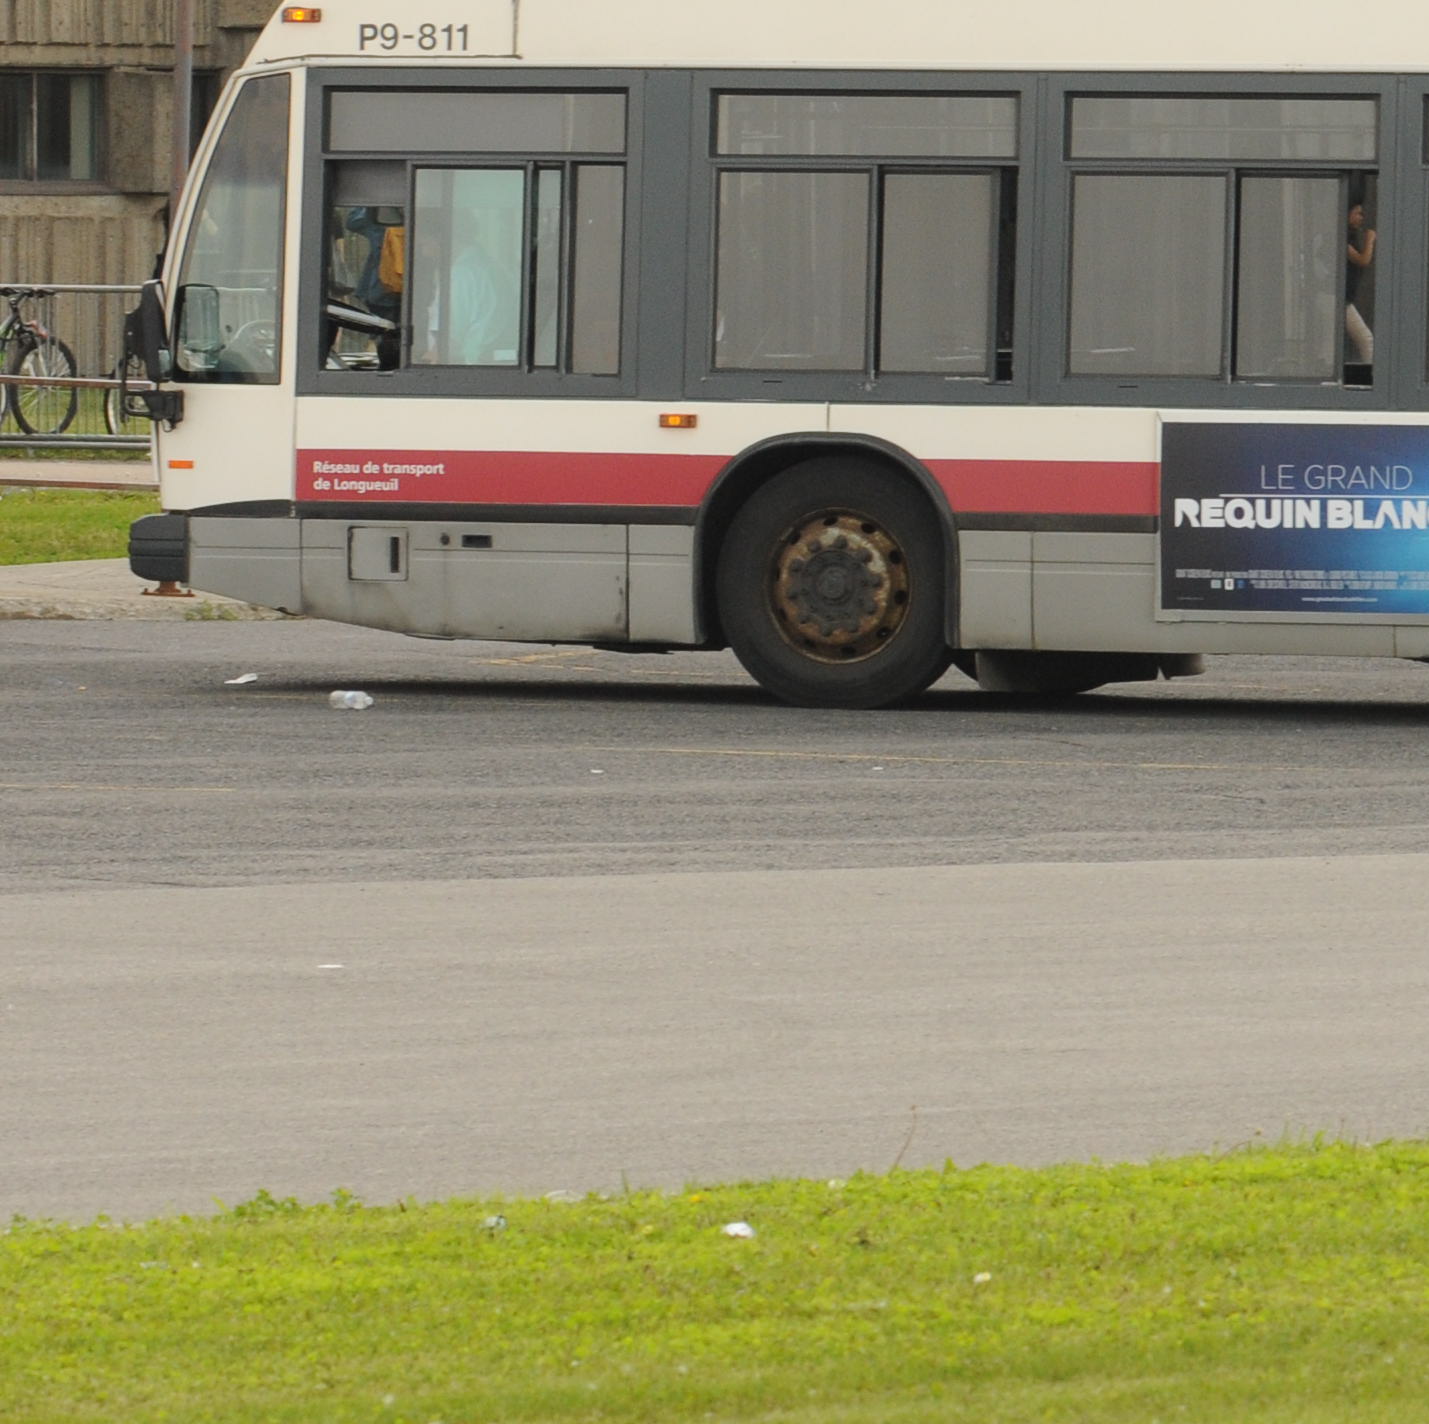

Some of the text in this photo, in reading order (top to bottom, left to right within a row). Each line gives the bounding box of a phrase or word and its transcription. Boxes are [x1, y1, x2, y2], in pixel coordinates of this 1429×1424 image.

[359, 23, 468, 51] P9-811
[313, 461, 445, 477] Réseau de transport
[1260, 464, 1413, 491] LE GRAND
[313, 477, 399, 493] de Longueuil
[1174, 498, 1321, 529] REQUIN
